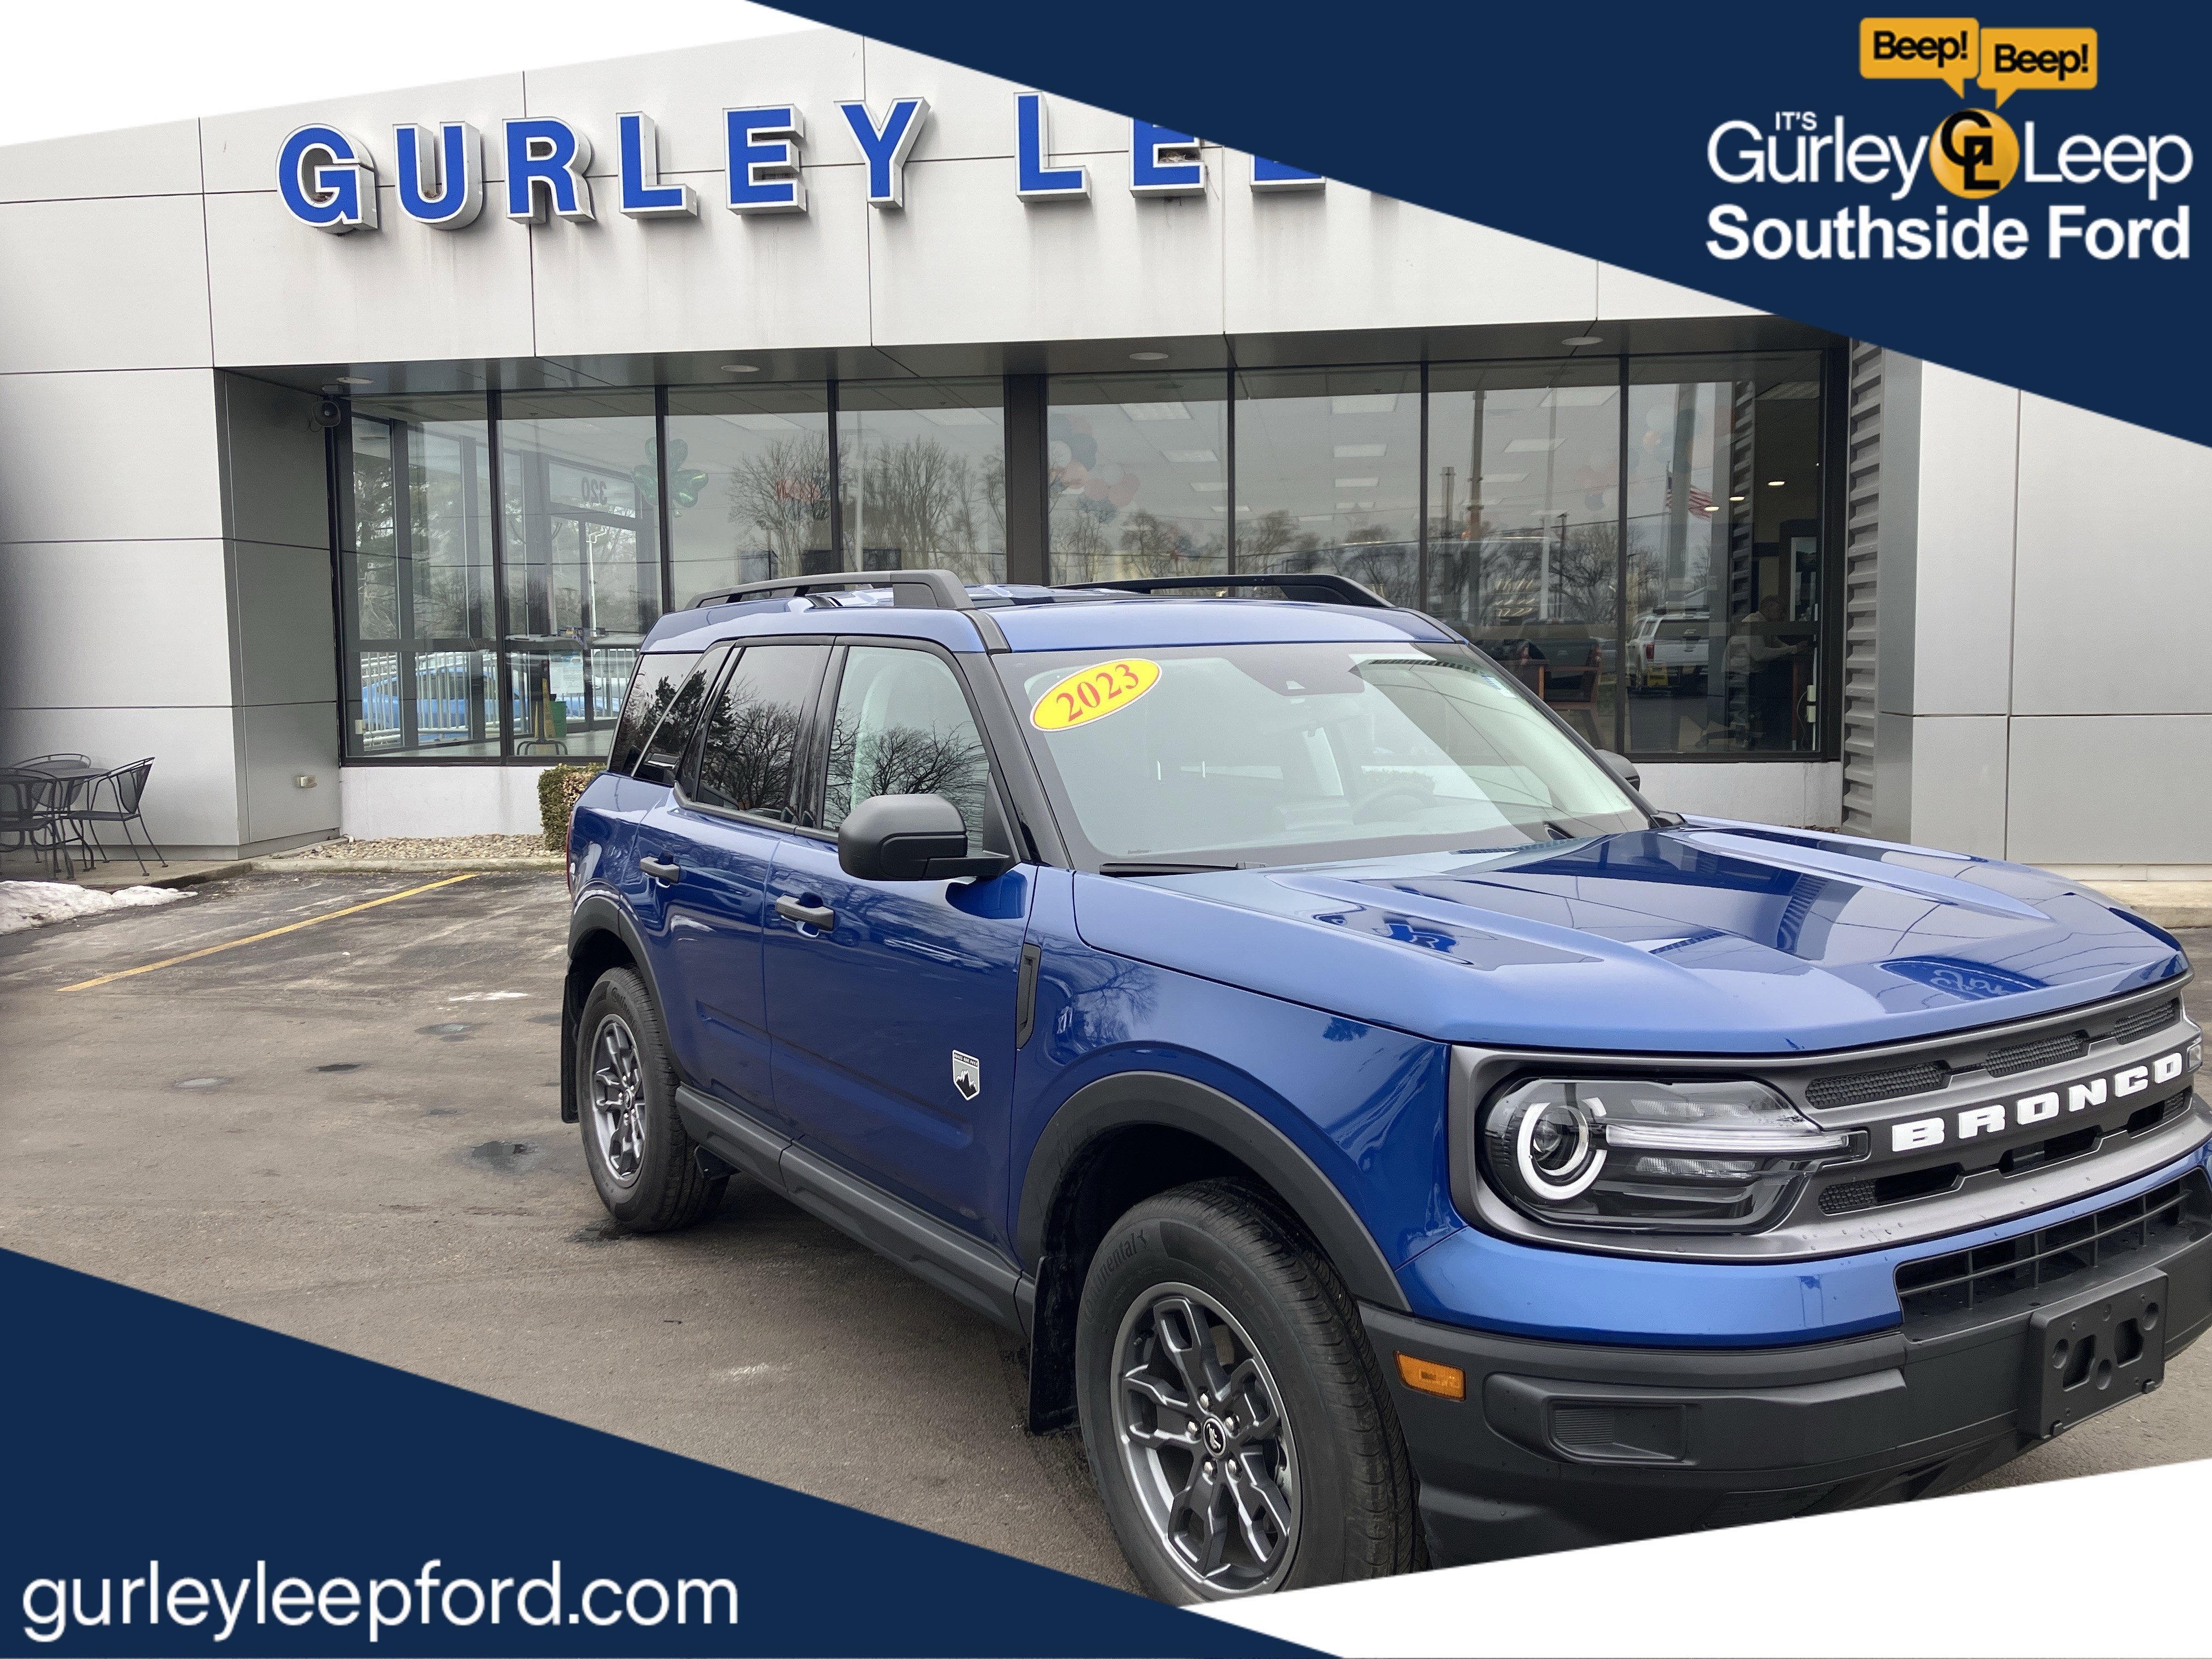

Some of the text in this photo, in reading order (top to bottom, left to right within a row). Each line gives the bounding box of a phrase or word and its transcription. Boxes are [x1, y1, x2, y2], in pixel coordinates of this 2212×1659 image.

[275, 96, 932, 233] GURLEY
[1056, 664, 1139, 723] 2023
[1891, 1052, 2183, 1152] BRONCO
